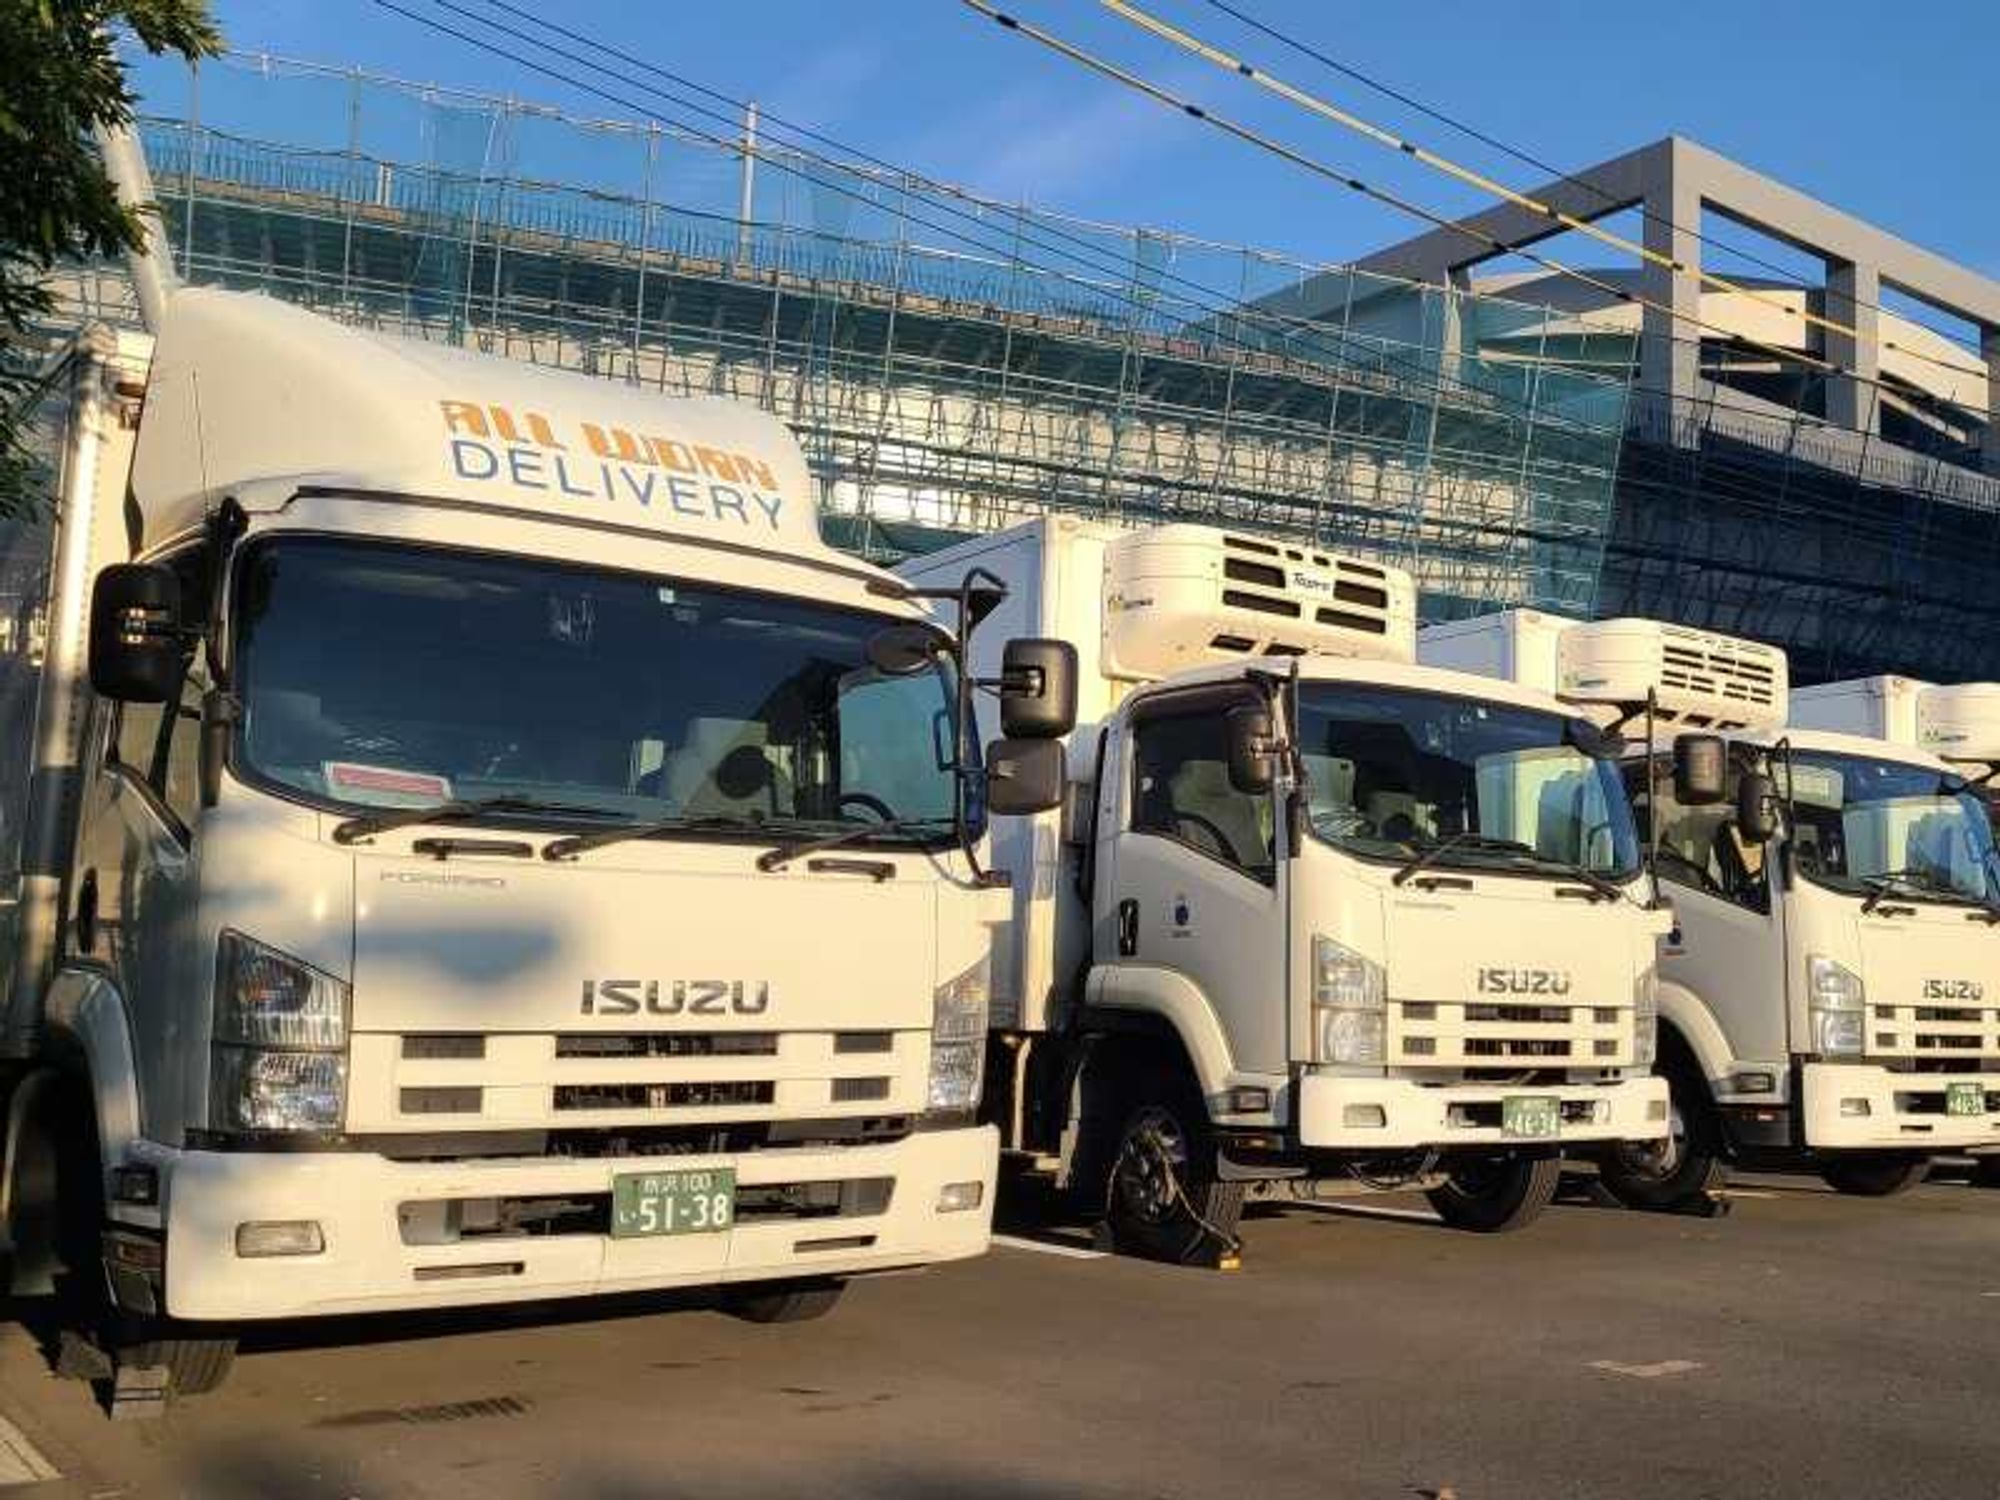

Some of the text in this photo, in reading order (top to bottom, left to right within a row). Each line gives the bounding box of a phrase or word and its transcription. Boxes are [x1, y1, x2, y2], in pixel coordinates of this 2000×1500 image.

[440, 400, 567, 450] ALL
[451, 439, 782, 531] DELIVERY
[580, 980, 769, 1015] ISUZU
[1478, 967, 1570, 995] ISUZU
[1923, 979, 1983, 1001] ISUZU
[682, 1172, 713, 1193] 100
[639, 1192, 729, 1232] 51-38
